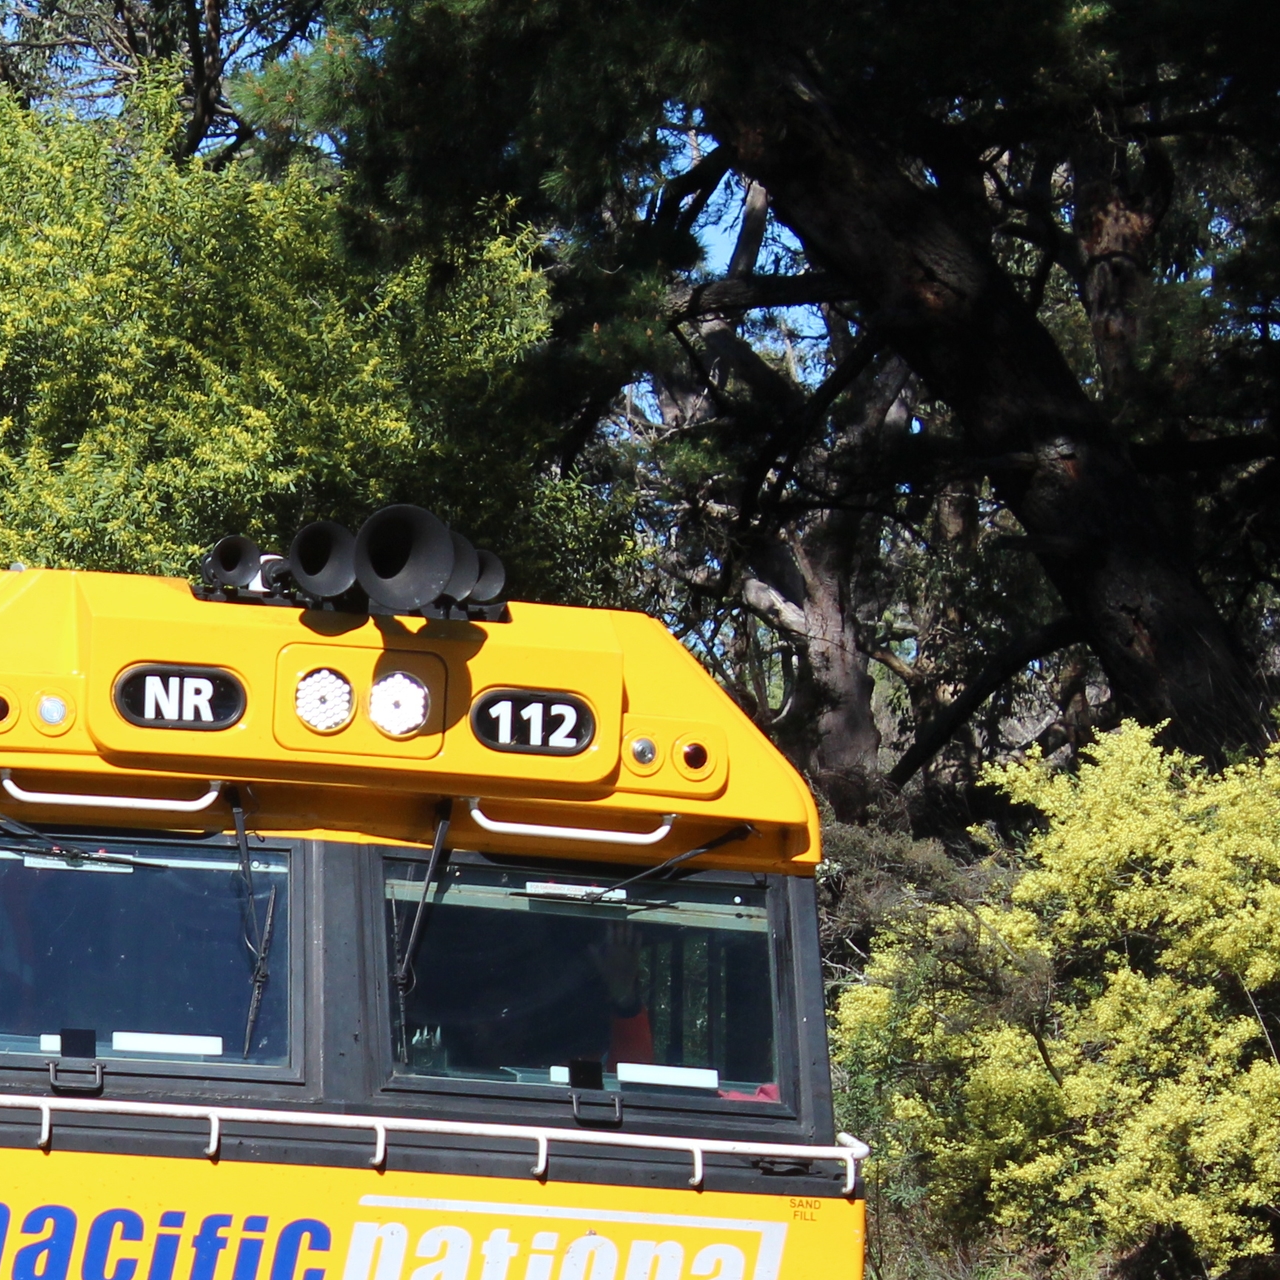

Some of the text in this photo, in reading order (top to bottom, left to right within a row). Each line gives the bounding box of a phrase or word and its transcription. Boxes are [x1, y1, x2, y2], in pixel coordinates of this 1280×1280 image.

[143, 676, 215, 722] NR
[487, 700, 577, 748] 112
[789, 1198, 822, 1210] SAND
[793, 1210, 817, 1222] FILL
